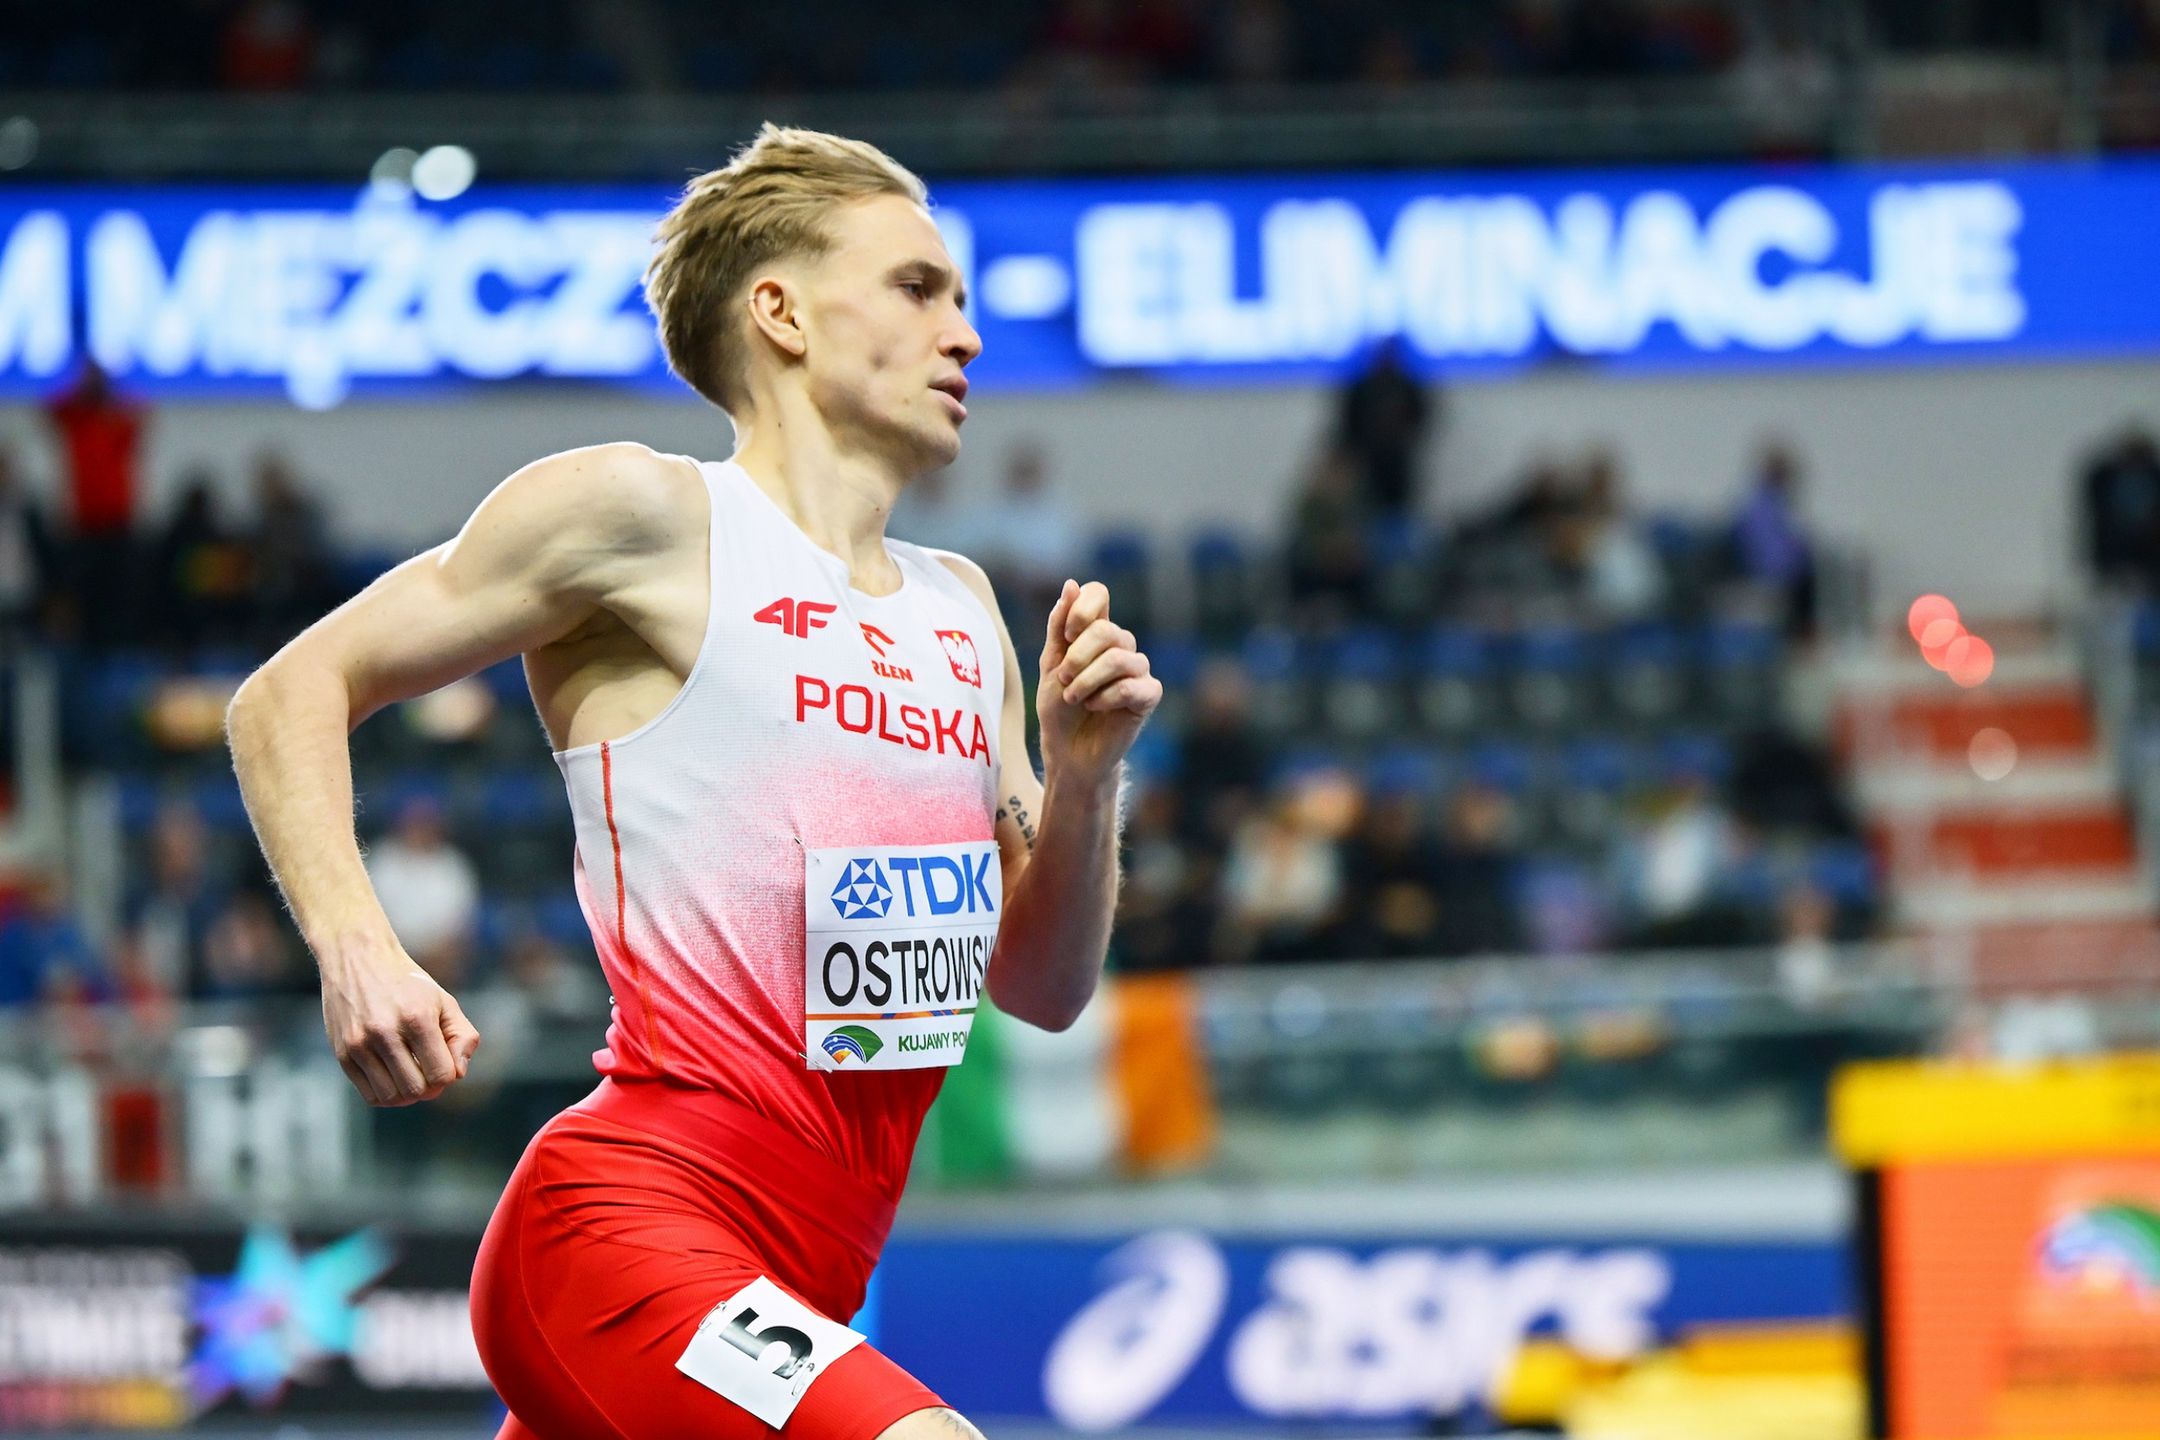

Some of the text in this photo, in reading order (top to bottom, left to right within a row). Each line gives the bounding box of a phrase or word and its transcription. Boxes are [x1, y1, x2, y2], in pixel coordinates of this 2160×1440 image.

[1076, 183, 2024, 368] ELIMINACJE
[753, 597, 837, 639] 4F
[871, 659, 914, 682] RLEN
[795, 674, 991, 767] POLSKA
[888, 852, 995, 917] TDK
[898, 1032, 950, 1052] KUJAWY
[718, 1307, 814, 1381] 5
